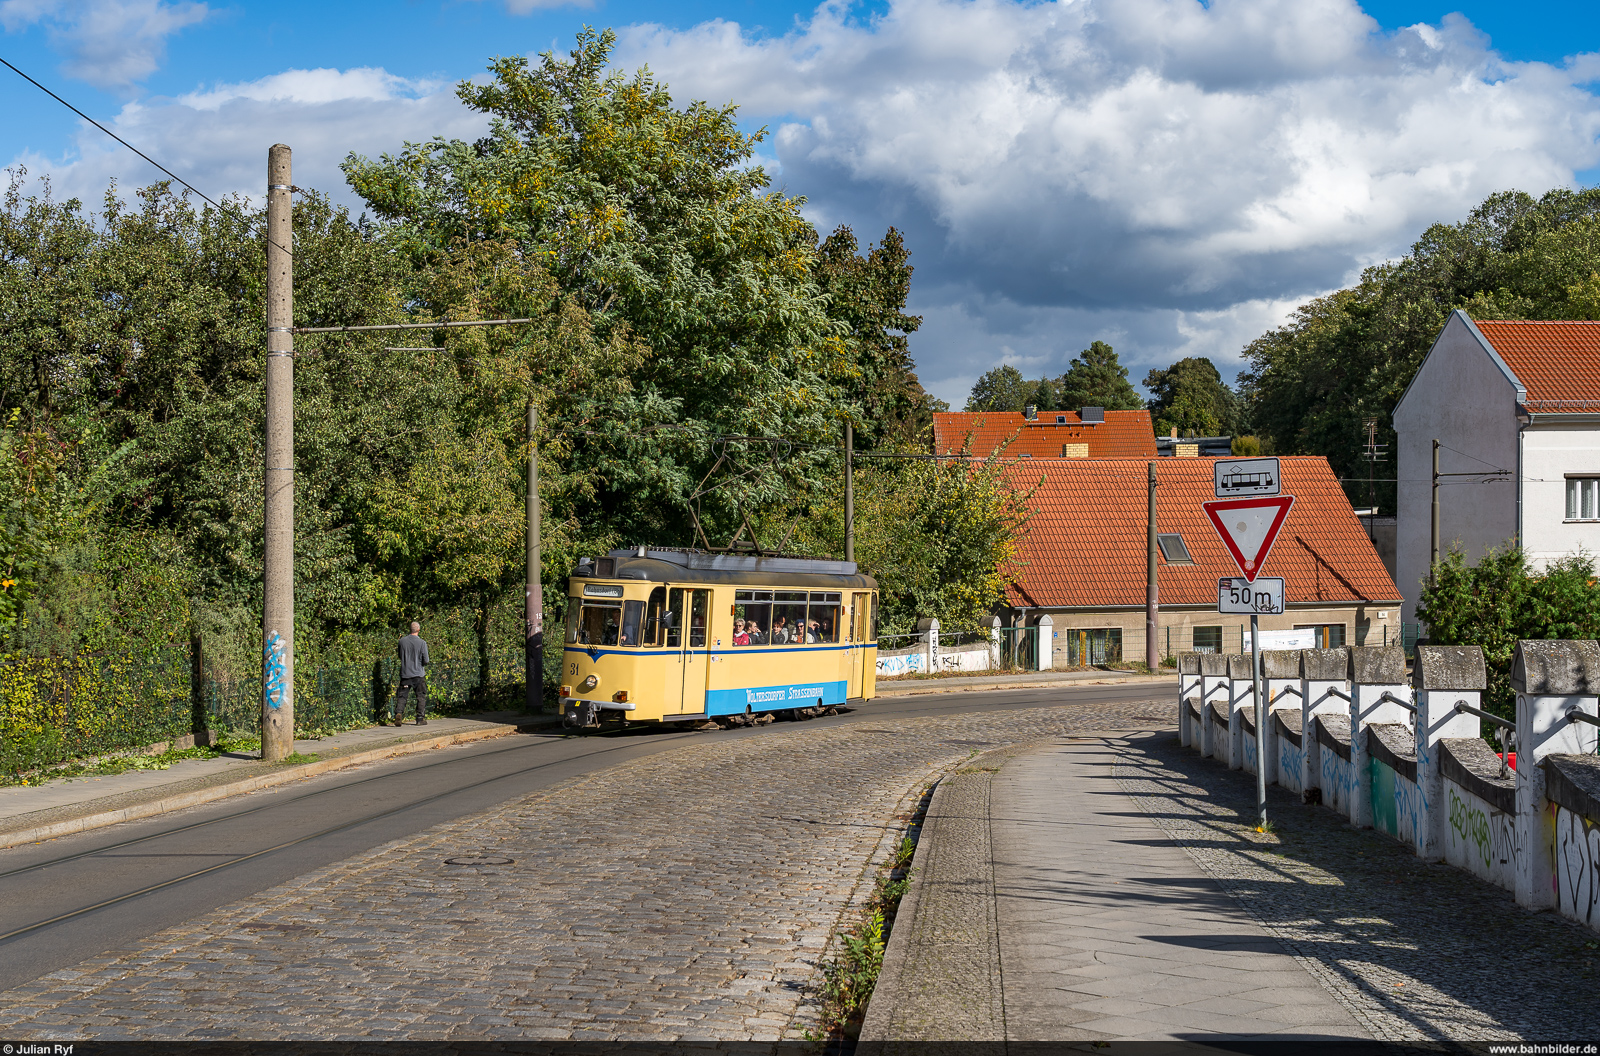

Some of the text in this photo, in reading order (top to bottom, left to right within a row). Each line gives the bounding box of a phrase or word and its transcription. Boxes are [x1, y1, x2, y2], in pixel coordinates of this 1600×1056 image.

[1230, 587, 1271, 605] 50 m
[570, 662, 579, 676] 31
